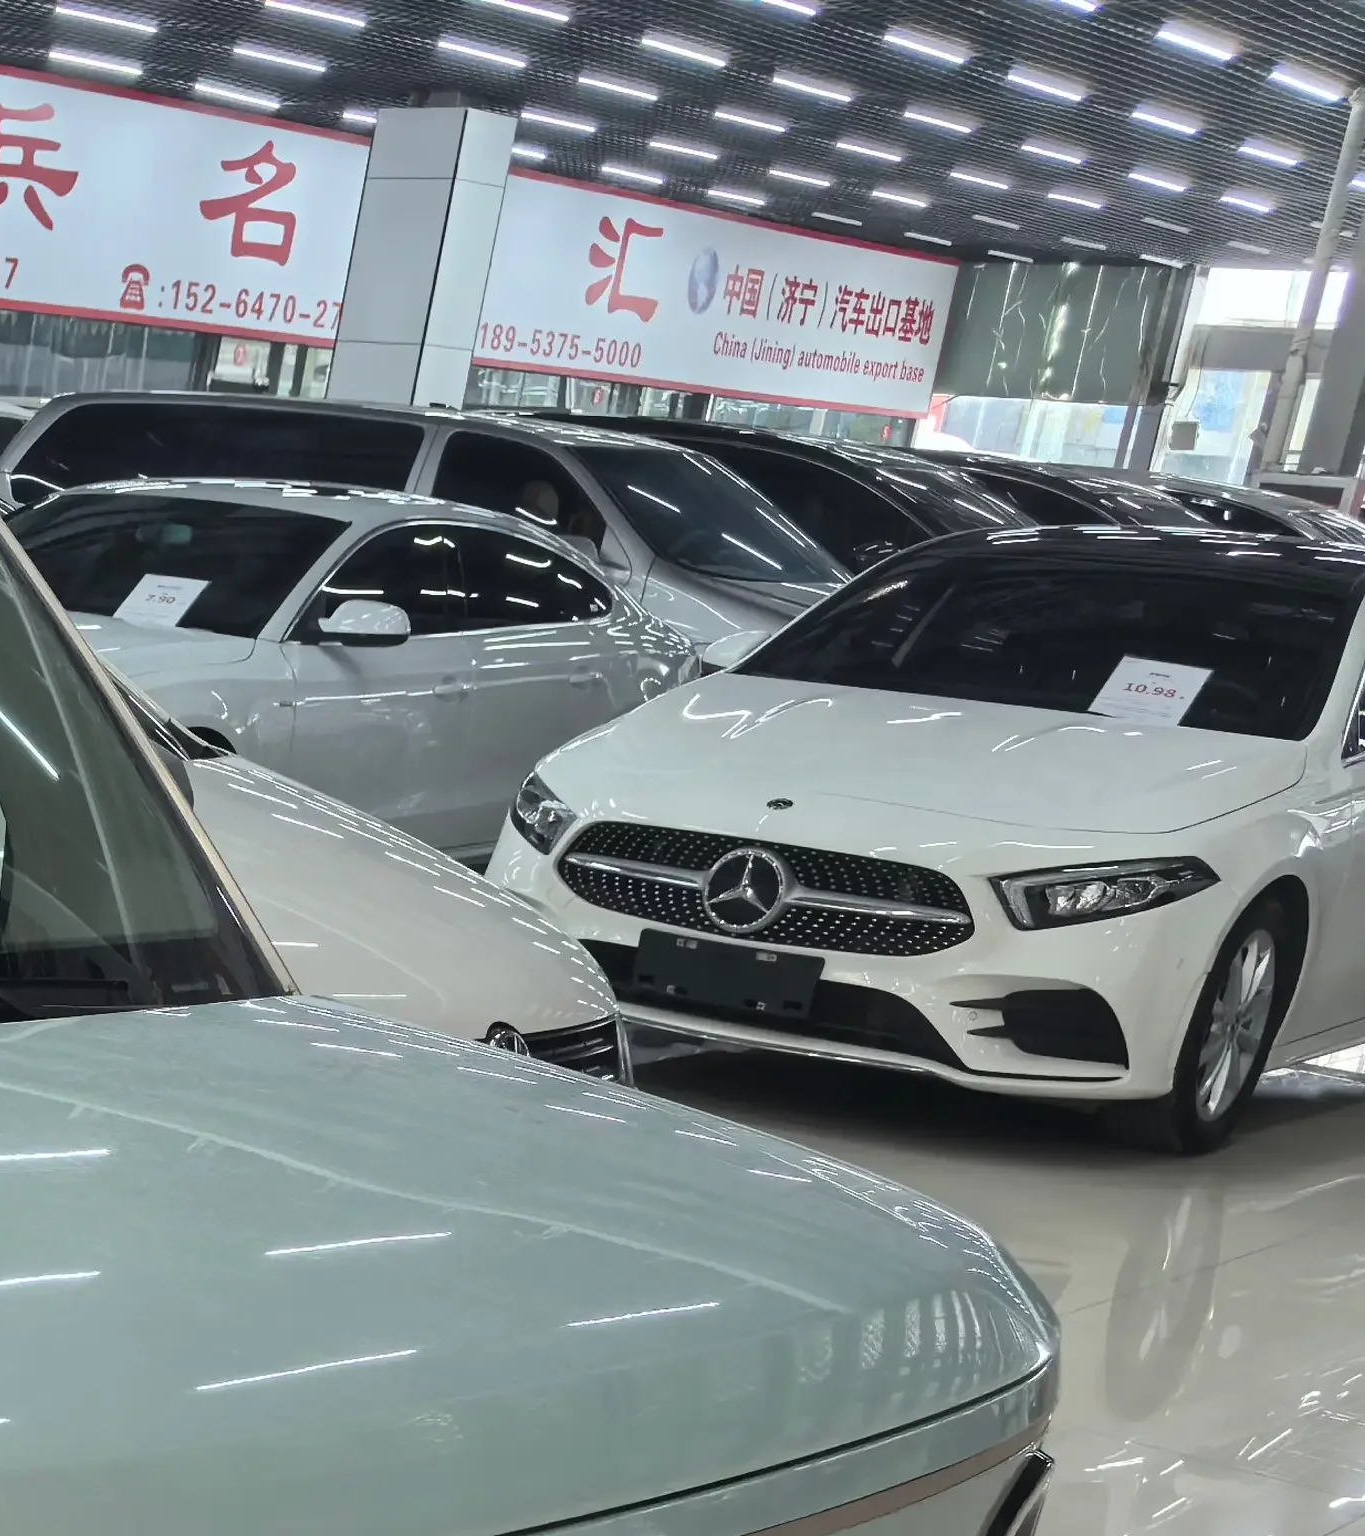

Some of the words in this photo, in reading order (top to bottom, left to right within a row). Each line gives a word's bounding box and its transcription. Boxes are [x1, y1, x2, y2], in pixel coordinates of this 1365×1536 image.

[199, 140, 297, 266] 名
[584, 216, 664, 323] 汇
[479, 321, 642, 369] 189-5375-5000
[713, 331, 748, 359] China
[750, 337, 796, 371] (Jining)
[797, 350, 861, 375] automobile
[862, 360, 898, 382] export
[899, 361, 925, 383] base
